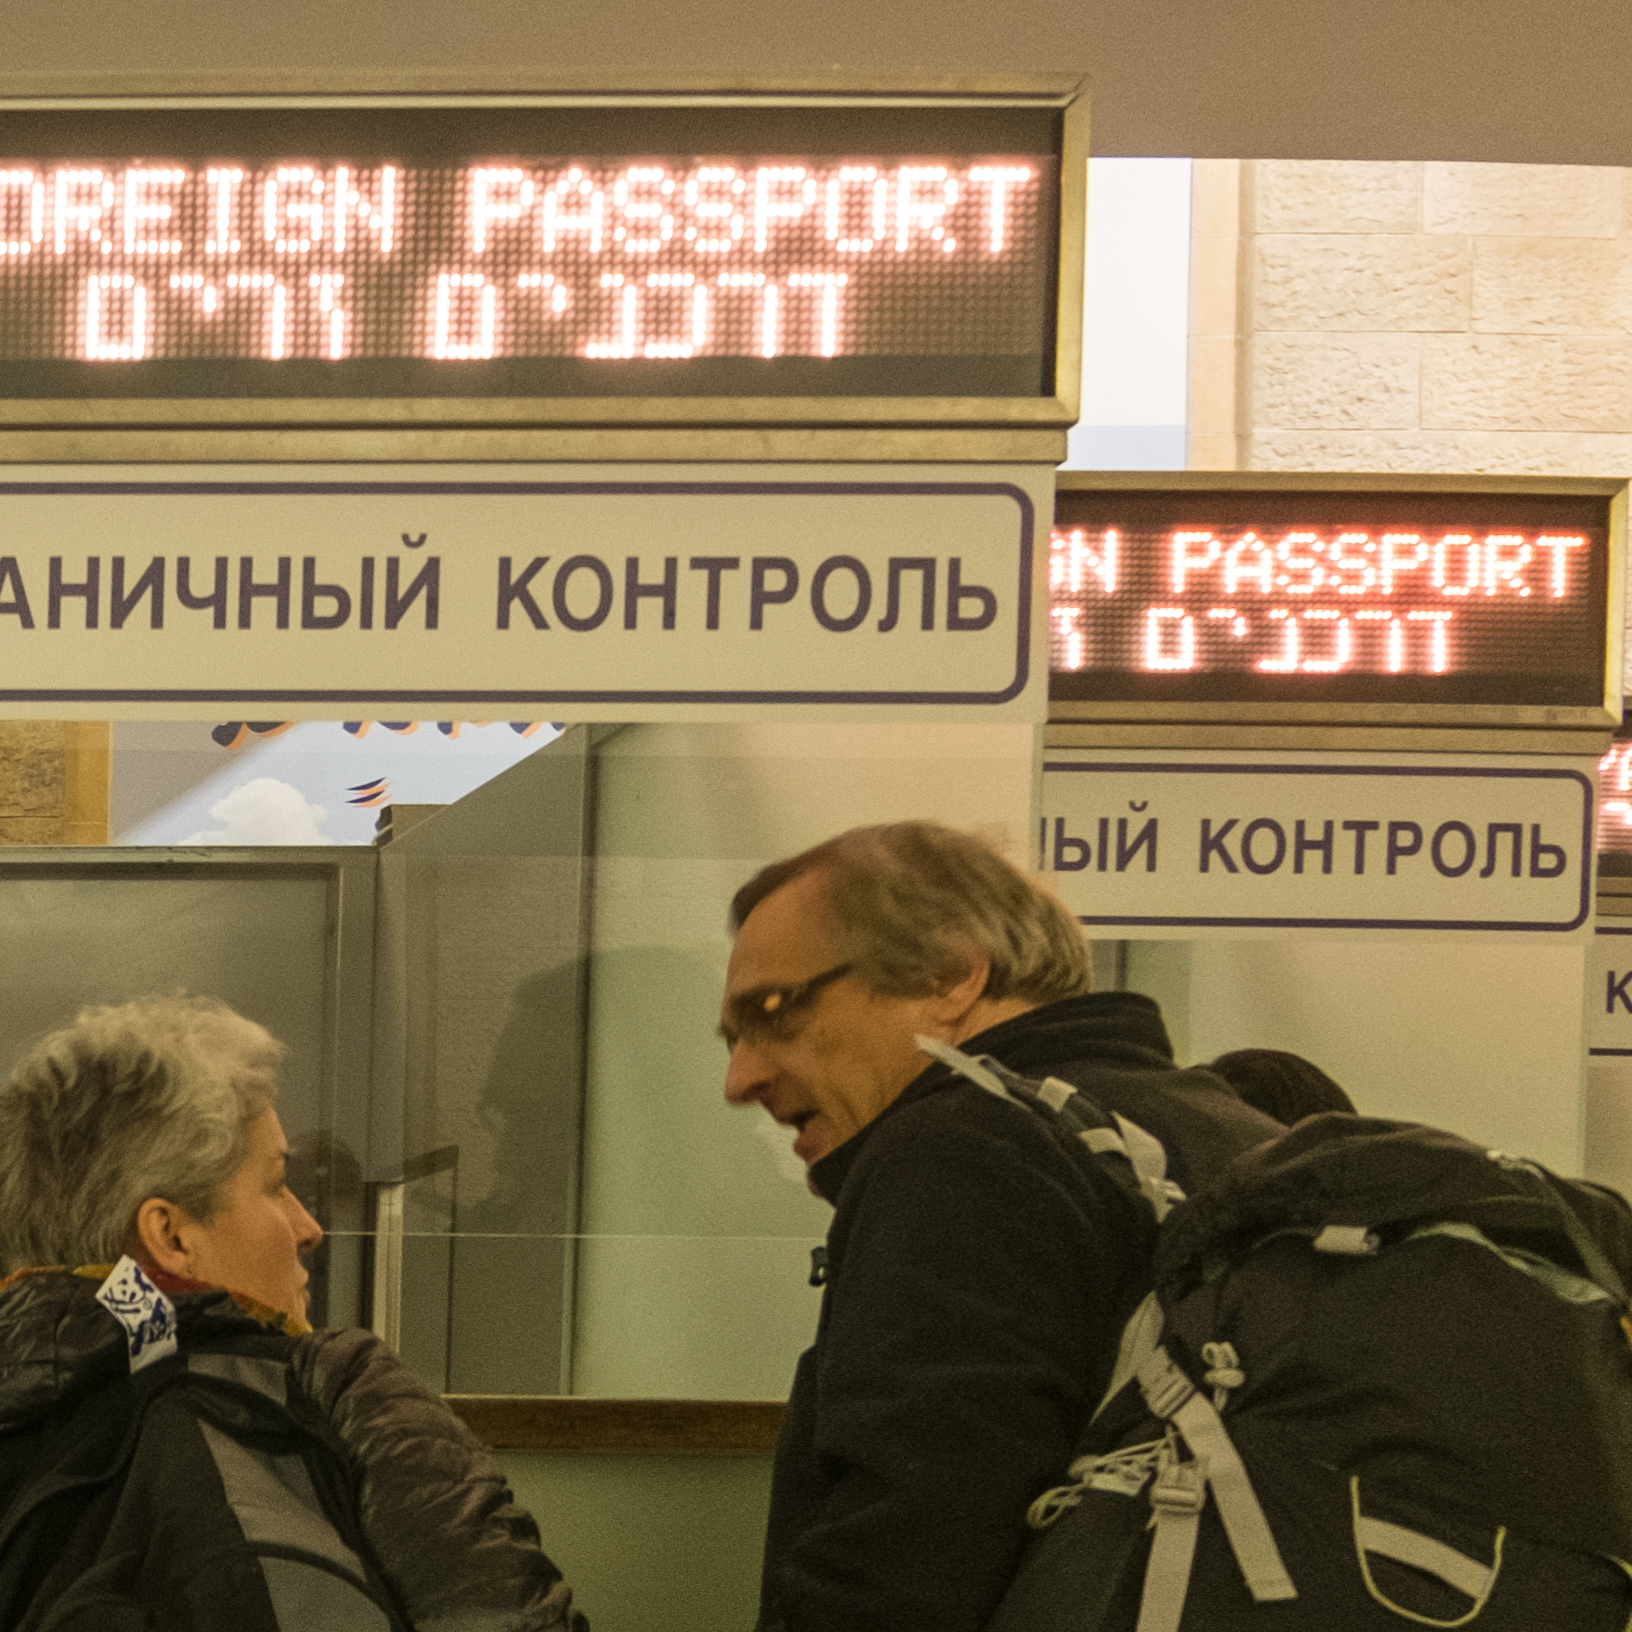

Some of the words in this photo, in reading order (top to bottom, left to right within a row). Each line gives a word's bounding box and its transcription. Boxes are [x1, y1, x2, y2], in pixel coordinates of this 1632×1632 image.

[472, 166, 1031, 253] PASSPORT
[85, 272, 346, 360] זרים
[434, 272, 850, 359] דרכנים
[496, 553, 998, 633] КОНТРОЛЬ
[1172, 530, 1587, 598] PASSPORT
[1146, 607, 1453, 673] דרכנים
[1198, 817, 1568, 879] КОНТРОЛЬ
